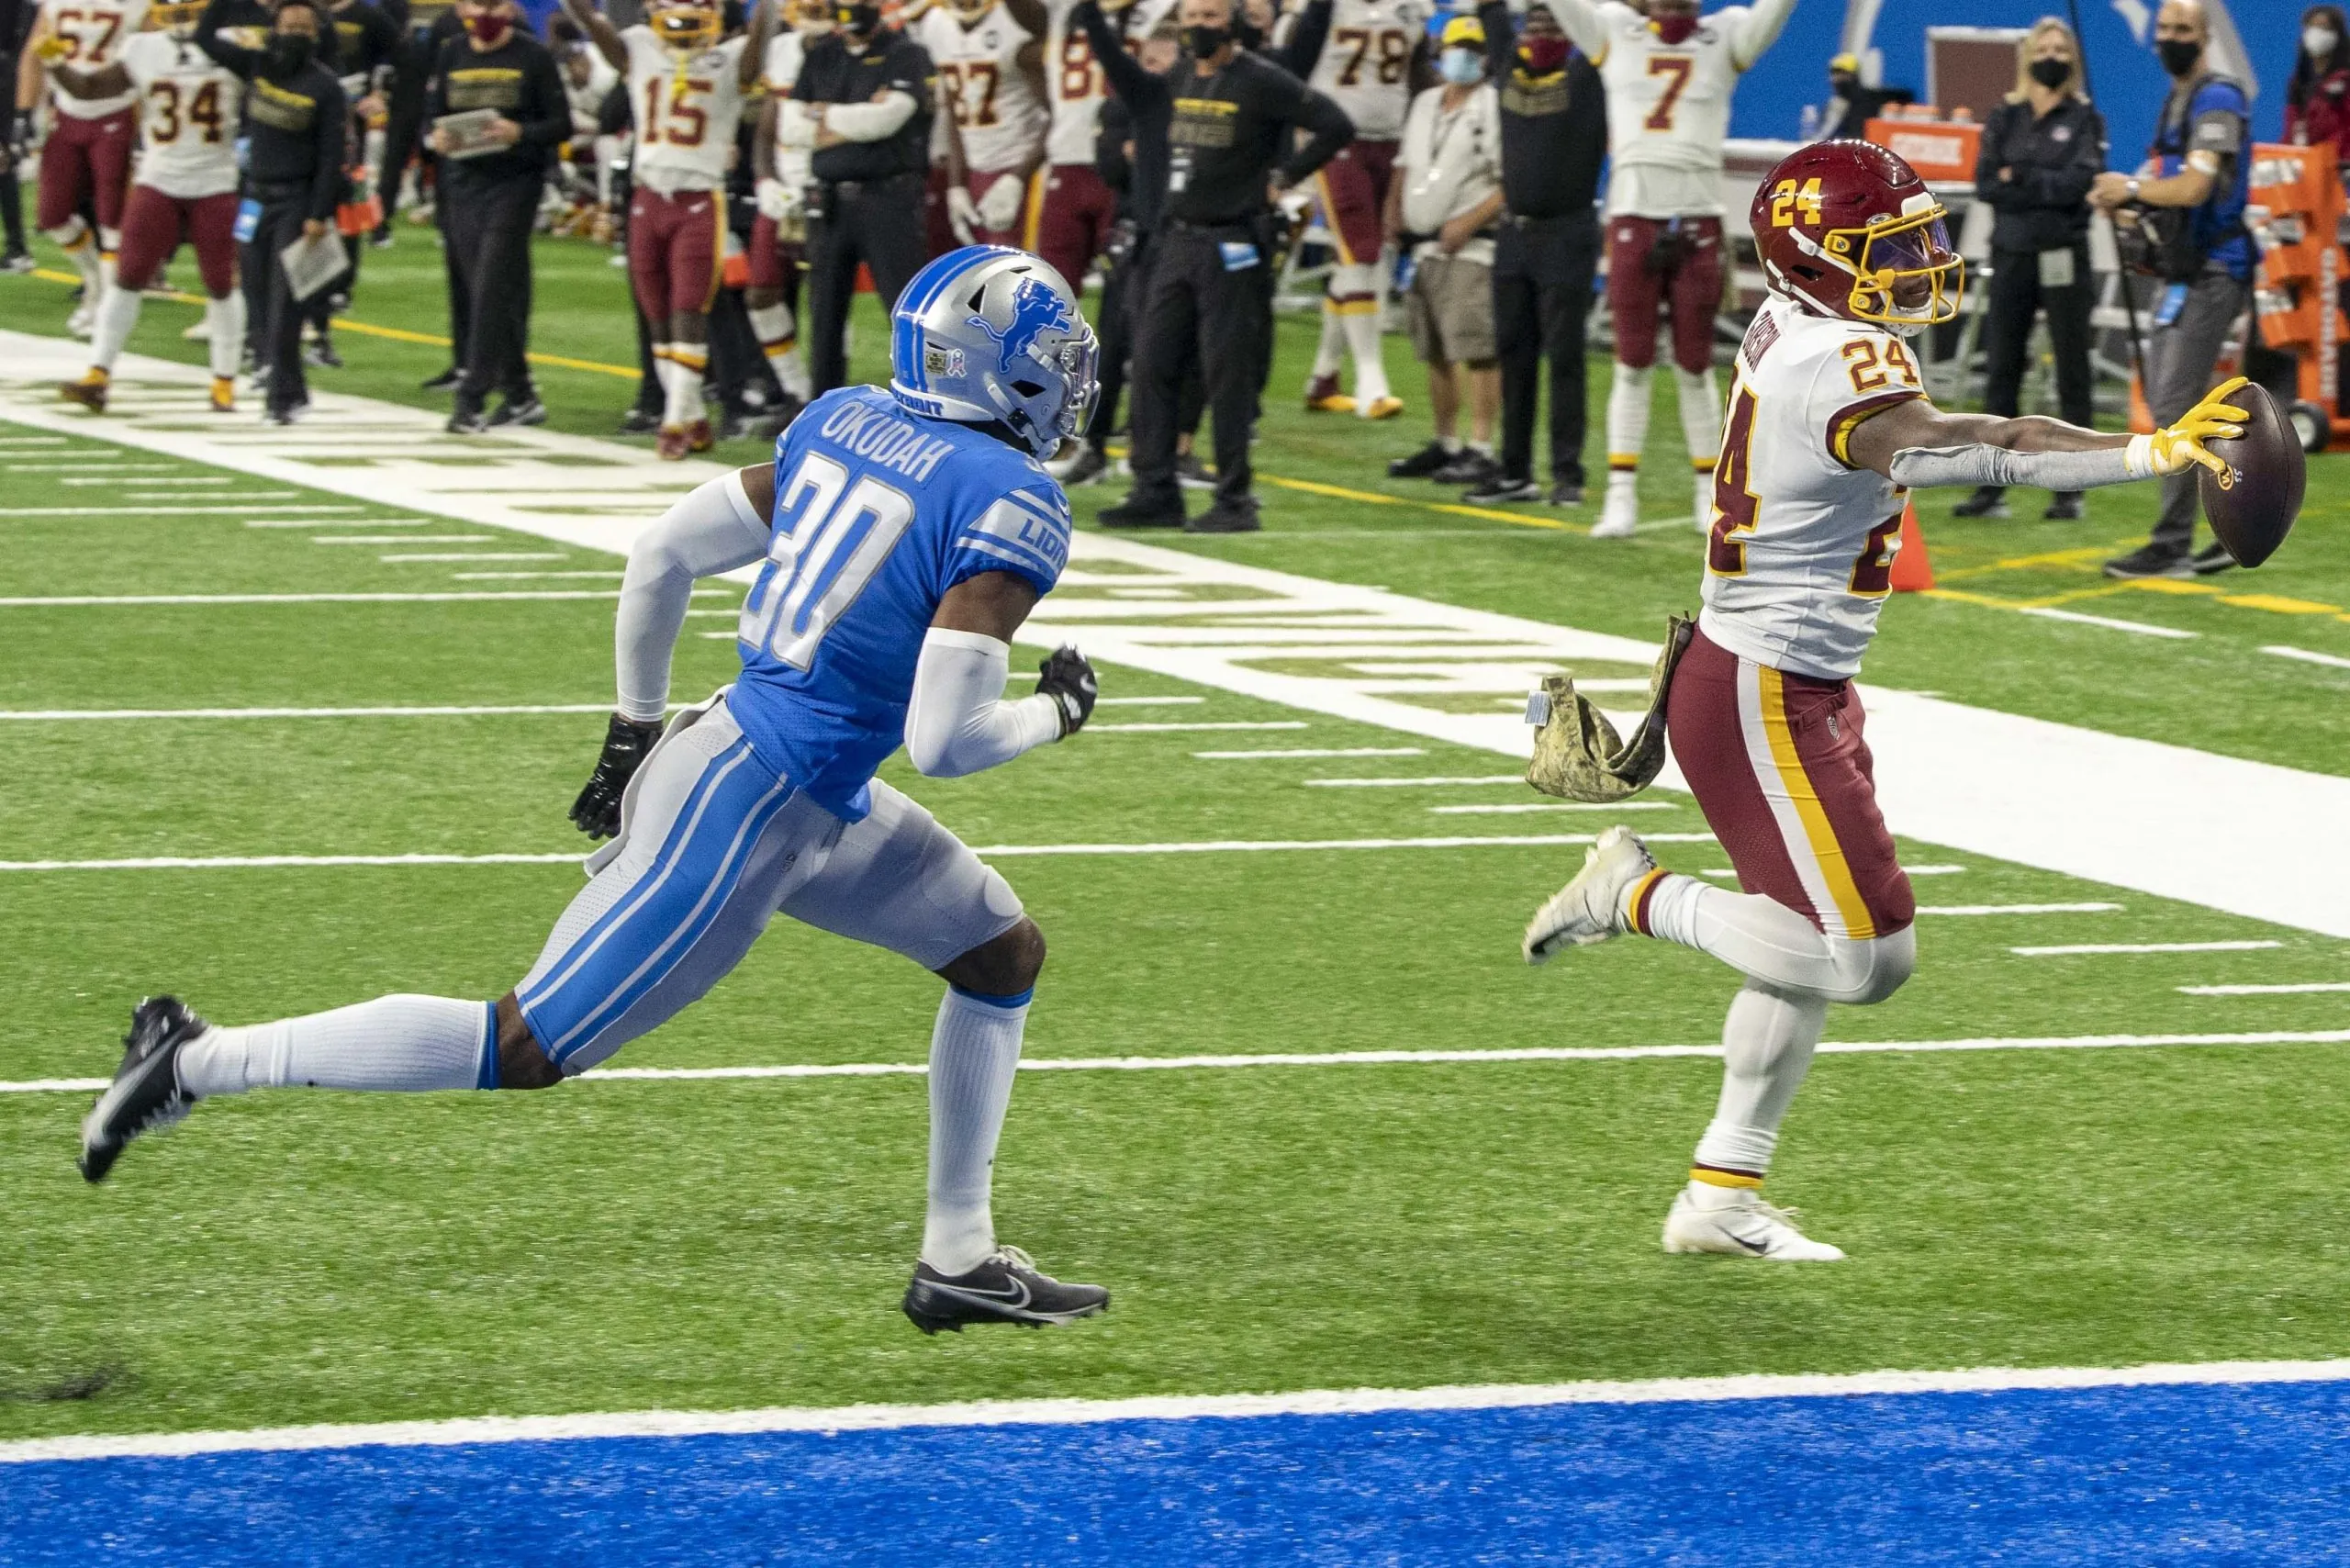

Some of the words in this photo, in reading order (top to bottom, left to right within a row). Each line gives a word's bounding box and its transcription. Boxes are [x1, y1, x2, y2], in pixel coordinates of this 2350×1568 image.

[1335, 28, 1412, 86] 78
[150, 80, 221, 142] 34
[643, 76, 713, 146] 15
[1644, 56, 1695, 132] 7
[1771, 177, 1822, 228] 24
[1841, 337, 1920, 395] 24
[821, 401, 956, 484] OKUDAH
[1708, 363, 1762, 577] 4
[737, 449, 915, 673] 30
[1017, 518, 1067, 567] LION
